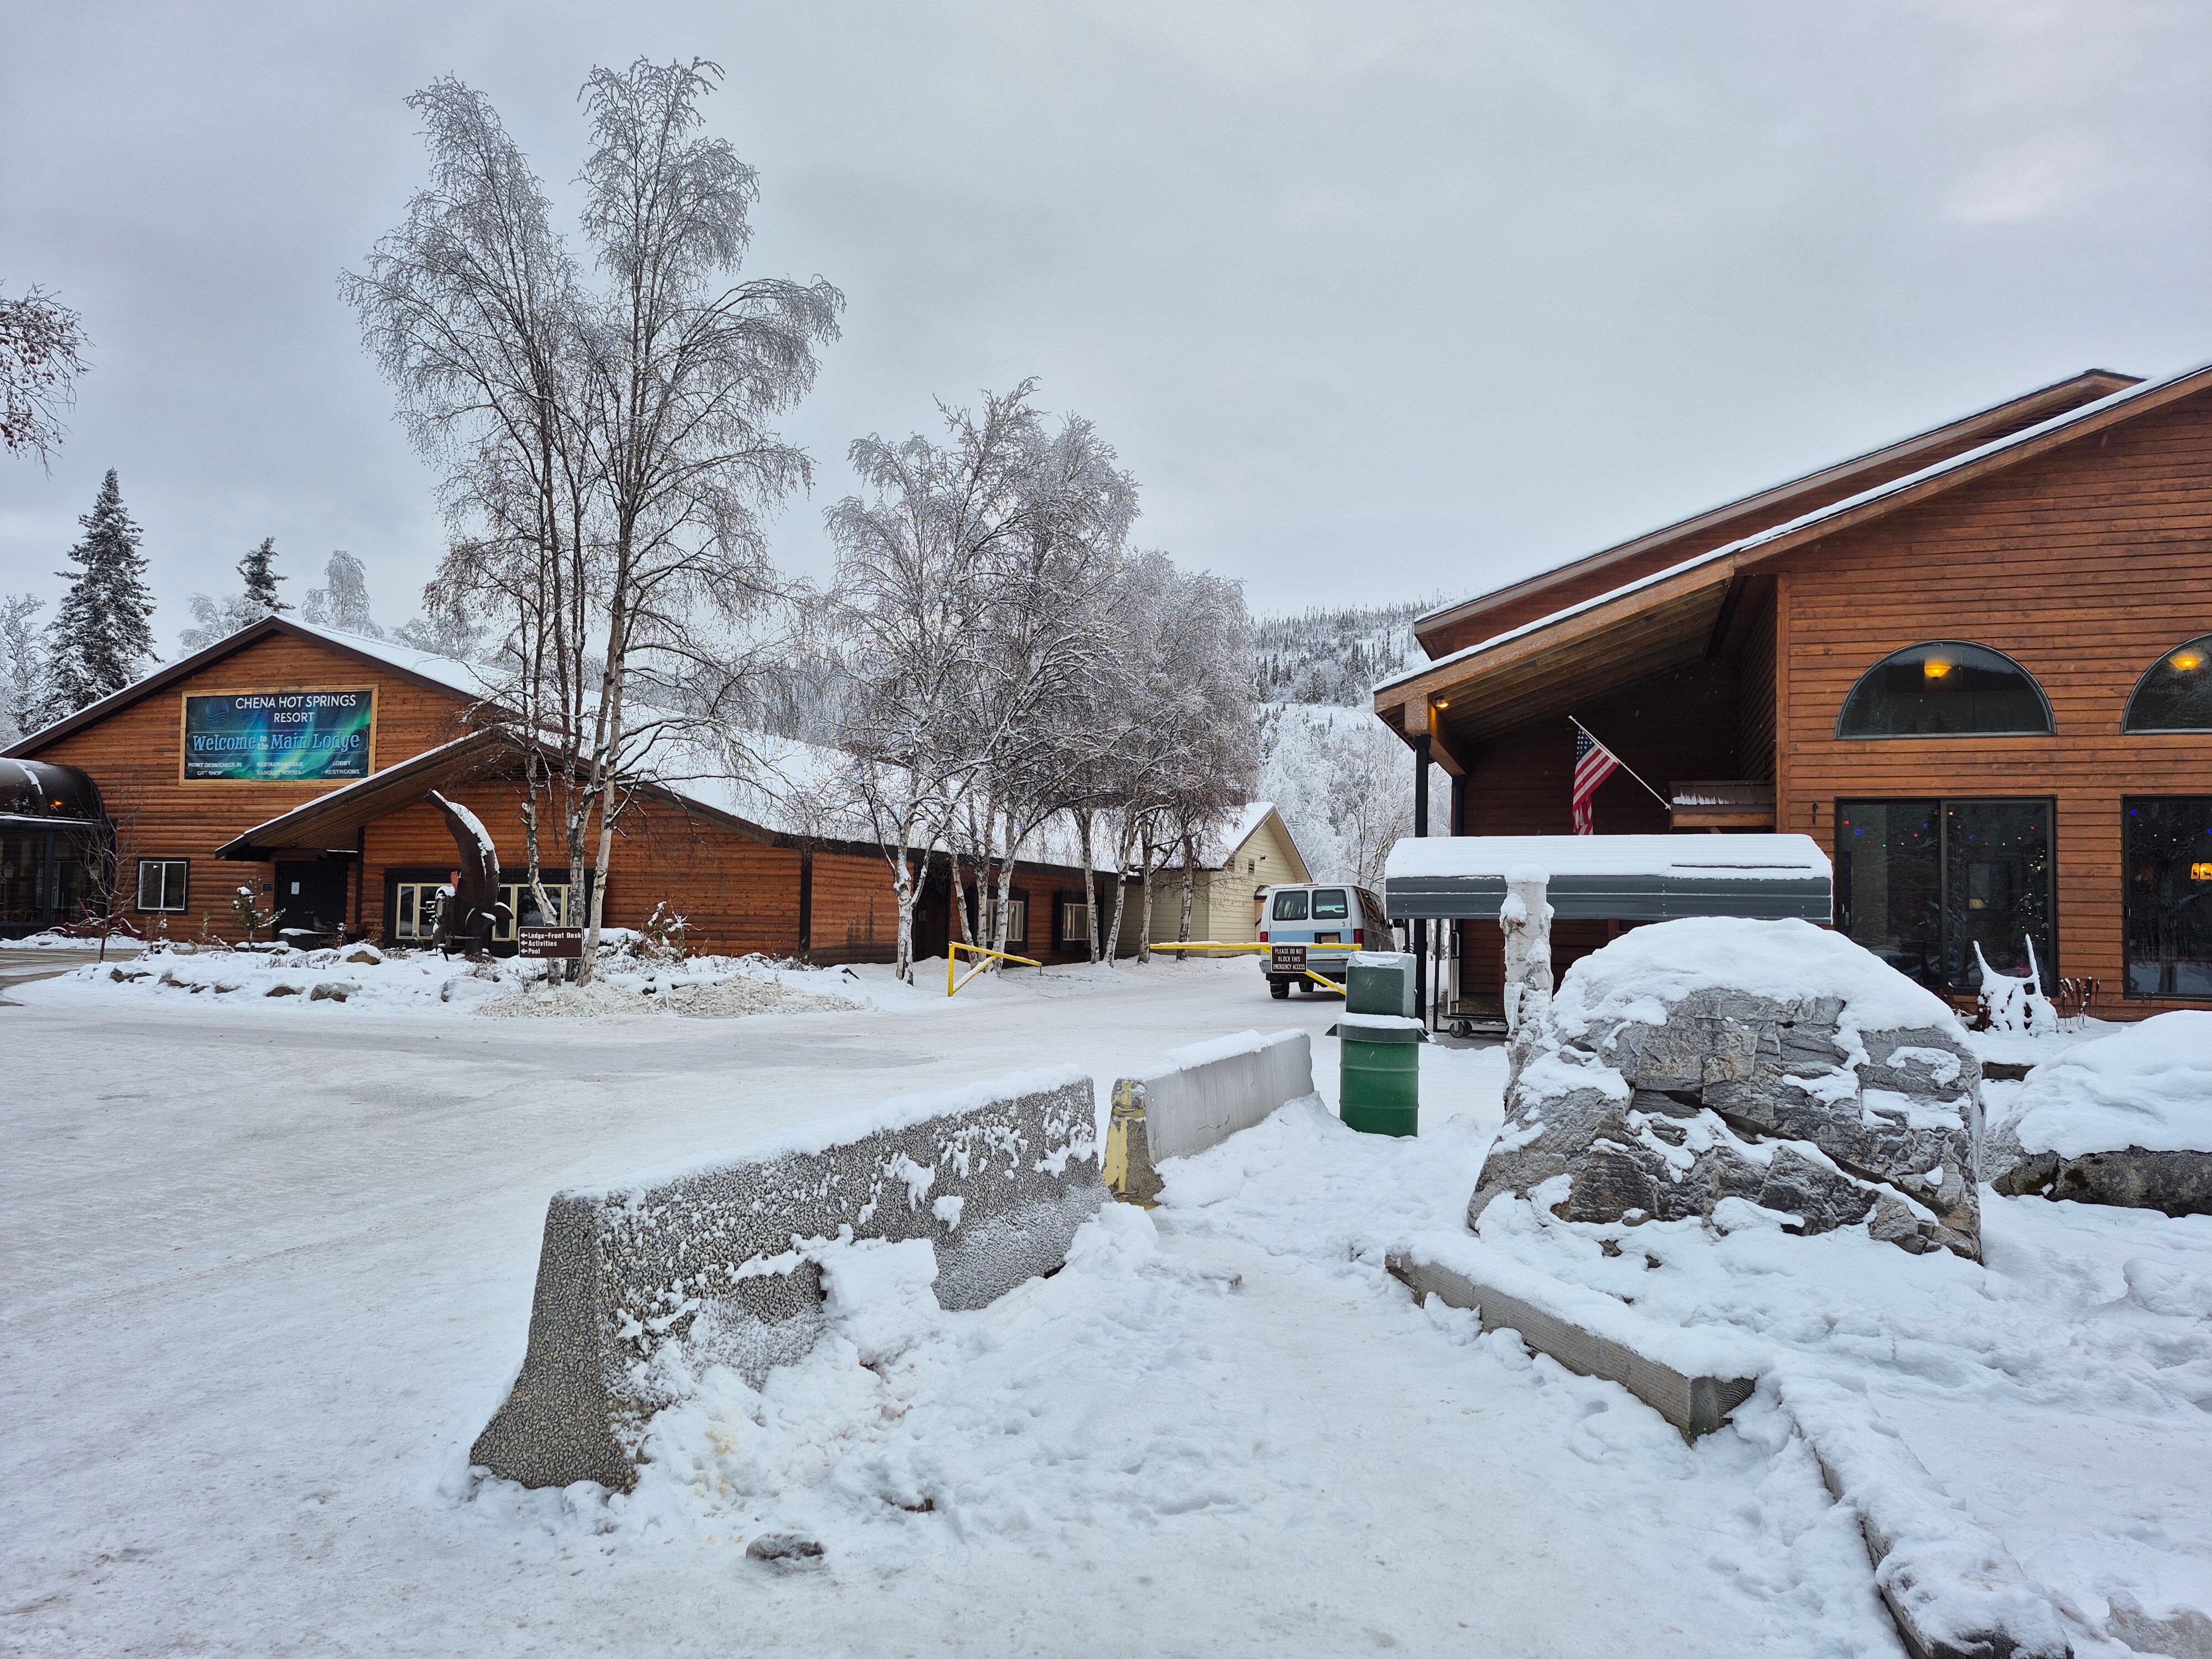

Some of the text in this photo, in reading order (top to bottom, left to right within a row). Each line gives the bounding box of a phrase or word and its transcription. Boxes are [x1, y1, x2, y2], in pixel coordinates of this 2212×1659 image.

[235, 694, 357, 709] CHENA HOT SPRINGS
[274, 712, 315, 723] RESORT
[192, 734, 257, 752] Welcome
[258, 742, 269, 750] the
[270, 732, 309, 750] Main
[311, 731, 361, 753] Lodge
